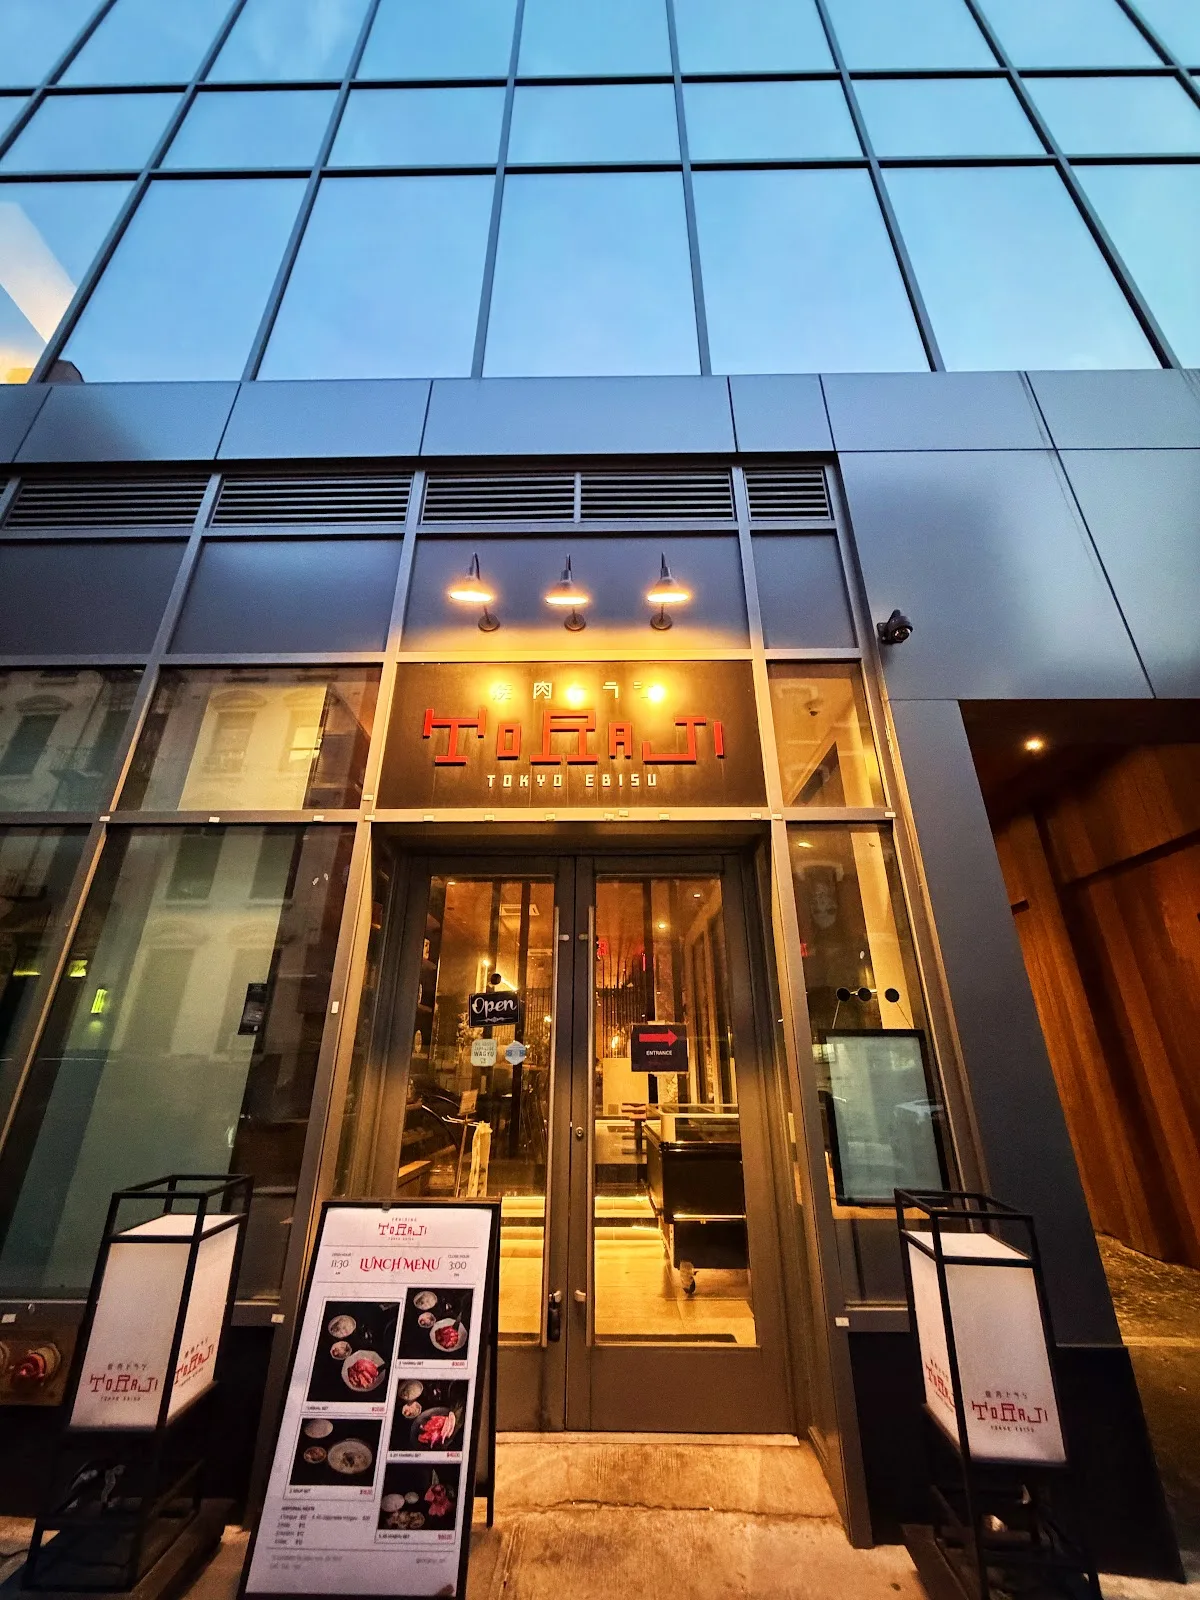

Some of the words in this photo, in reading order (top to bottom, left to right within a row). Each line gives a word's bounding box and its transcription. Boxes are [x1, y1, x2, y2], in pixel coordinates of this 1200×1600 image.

[487, 774, 563, 788] TOKYO
[585, 773, 658, 788] EBISU
[471, 997, 518, 1018] Open
[330, 1259, 350, 1269] 11:30
[359, 1256, 402, 1272] LUNCH
[402, 1256, 442, 1272] MENU
[449, 1261, 467, 1270] 3:00
